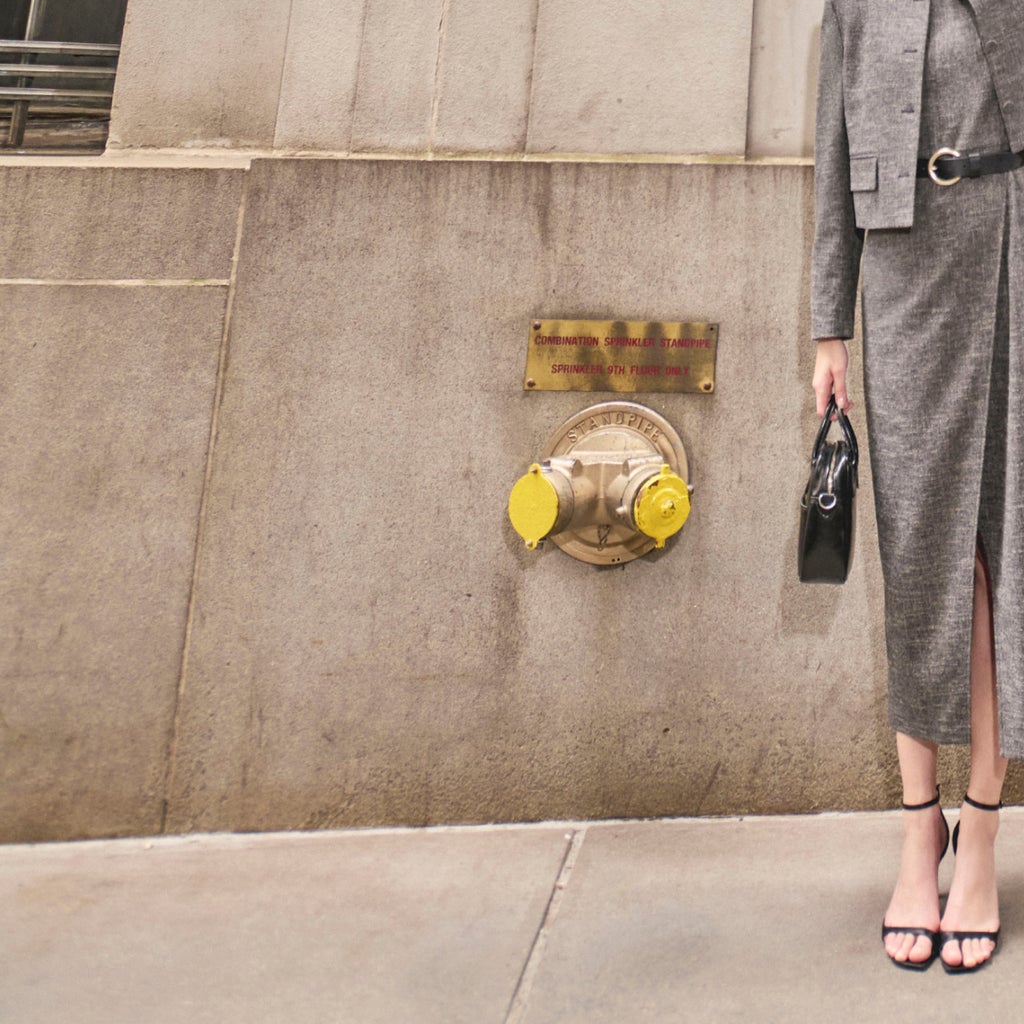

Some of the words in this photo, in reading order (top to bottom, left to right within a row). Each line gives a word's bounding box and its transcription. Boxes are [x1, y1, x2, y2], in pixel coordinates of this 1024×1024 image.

[534, 335, 599, 346] COMBINATION
[604, 337, 655, 348] SPRINKLER
[660, 338, 711, 348] STANDPIPE
[551, 364, 603, 374] SPRINKLER
[607, 365, 625, 375] 9TH
[630, 365, 659, 375] FLOOR
[665, 366, 690, 376] ONLY
[567, 412, 661, 444] STANDPIPE
